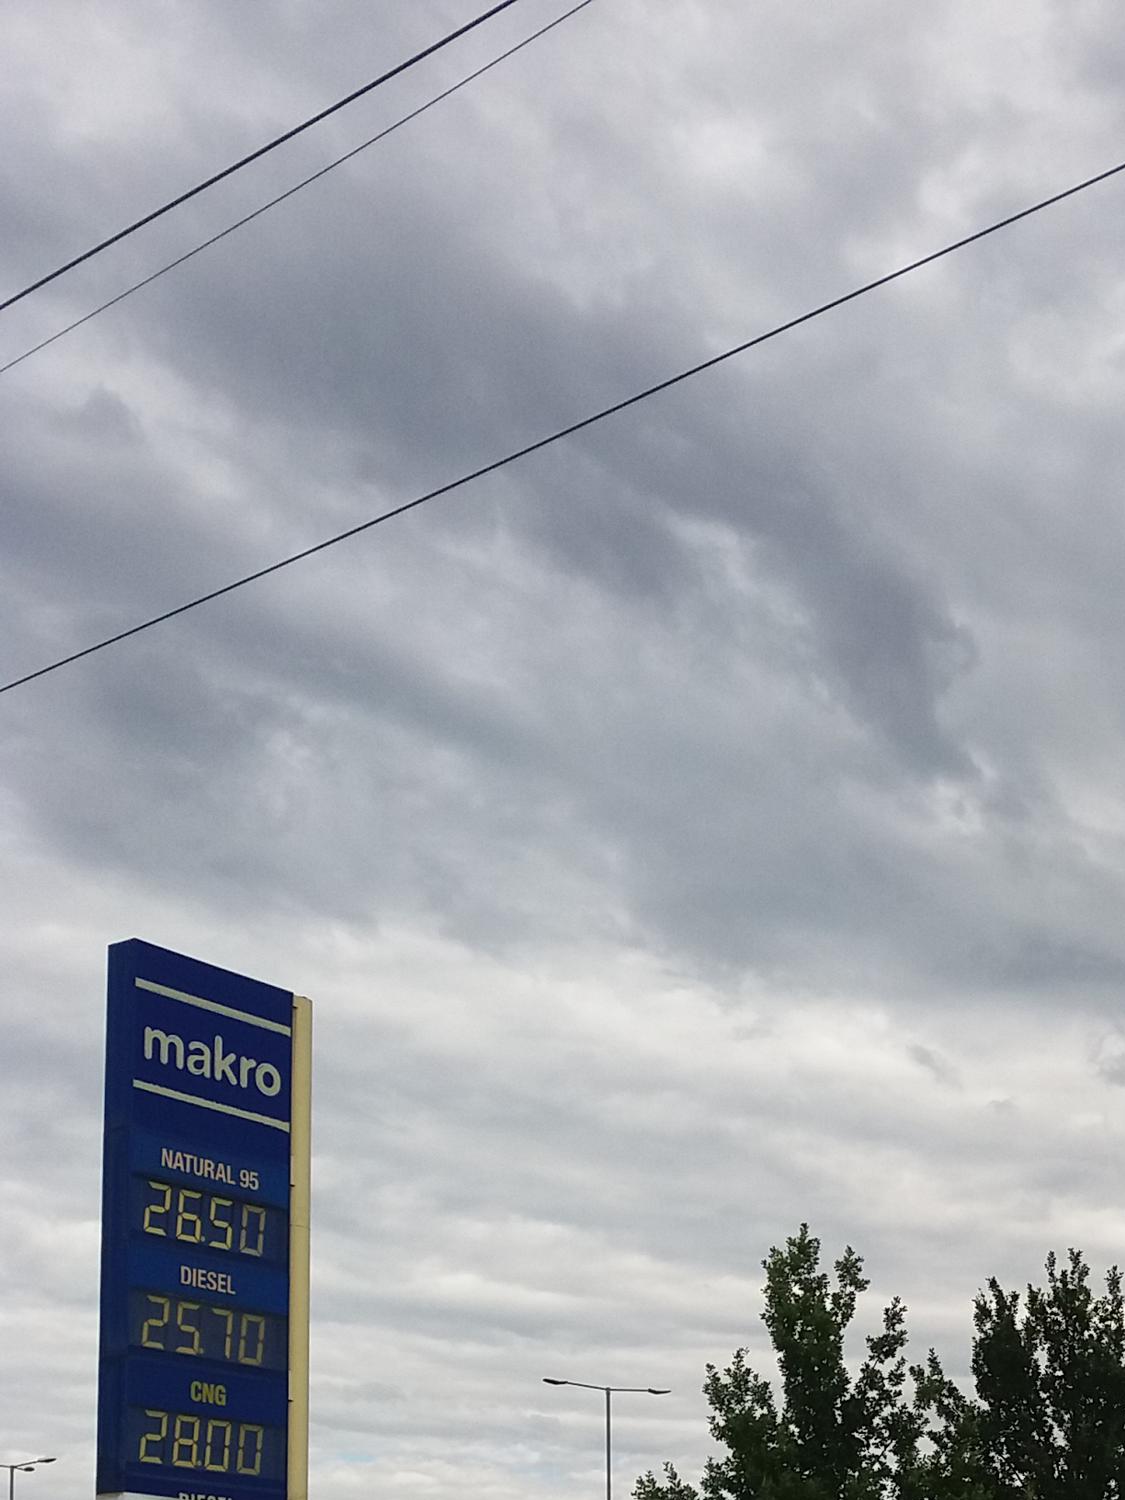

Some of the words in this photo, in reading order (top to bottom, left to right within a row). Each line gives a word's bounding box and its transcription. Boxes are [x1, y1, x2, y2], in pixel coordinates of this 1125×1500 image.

[143, 1025, 282, 1097] makro
[161, 1147, 236, 1184] NATURAL
[239, 1170, 260, 1191] 95
[180, 1265, 236, 1295] DIESEL
[190, 1381, 226, 1406] CNG
